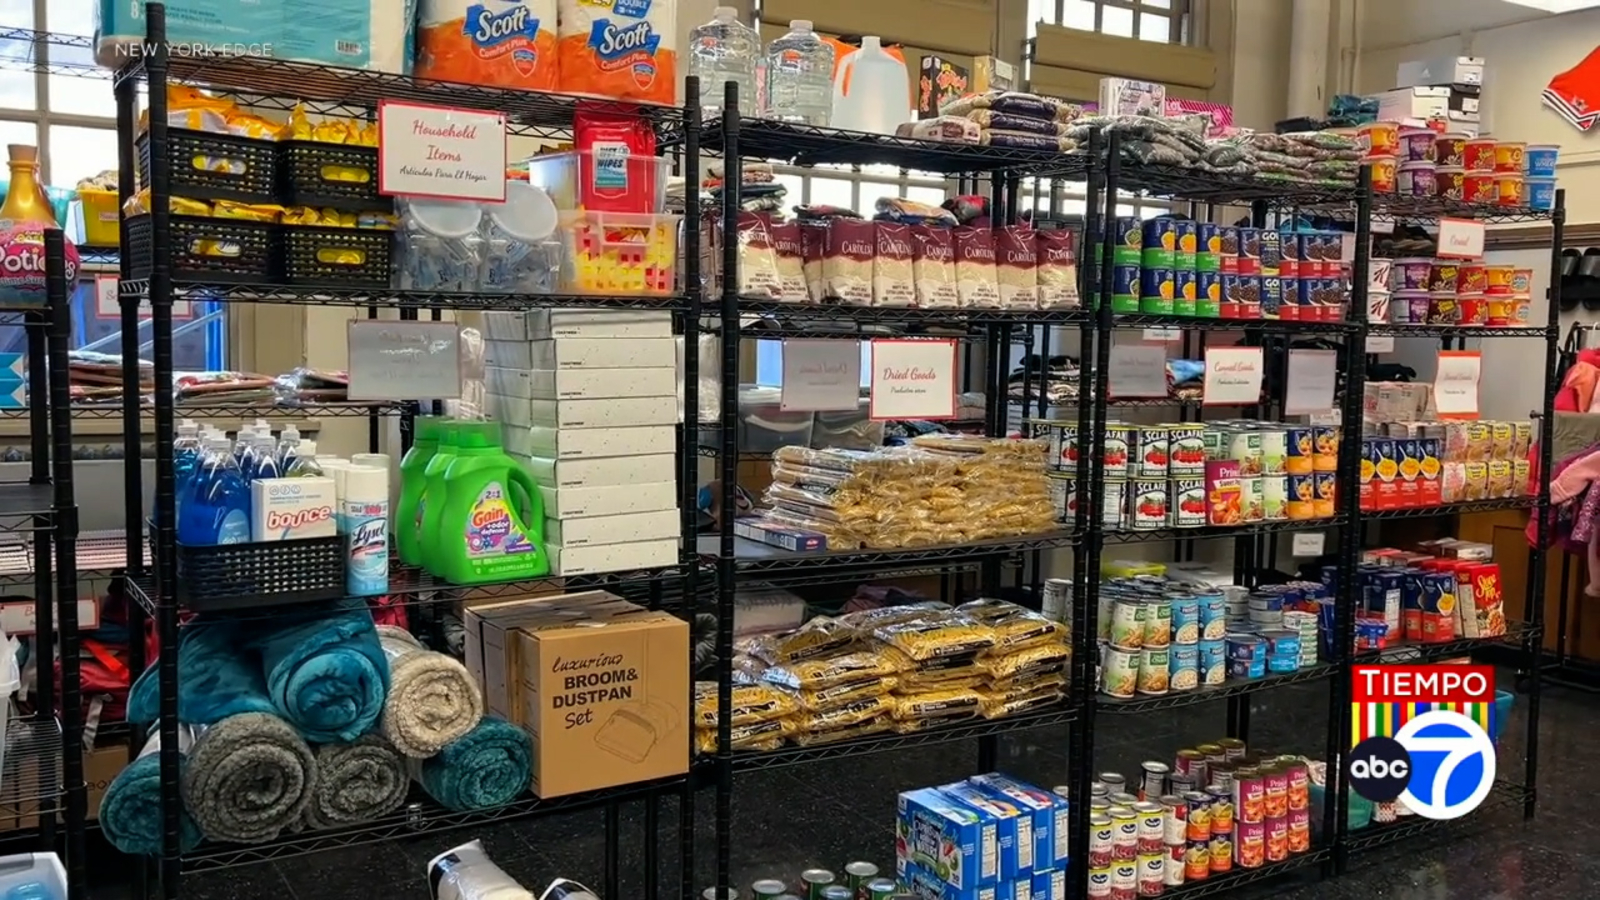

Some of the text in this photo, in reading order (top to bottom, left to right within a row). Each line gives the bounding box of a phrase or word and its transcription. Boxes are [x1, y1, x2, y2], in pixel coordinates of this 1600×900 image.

[475, 7, 527, 42] Scott
[479, 38, 528, 58] Comfort Plus
[599, 22, 649, 55] Scott
[601, 52, 648, 69] Comfort Plus
[412, 119, 478, 140] Household
[426, 144, 462, 162] Items
[597, 159, 624, 168] WIPES
[434, 168, 453, 178] Para
[465, 170, 487, 183] Hogar
[883, 366, 936, 381] Dried Goods
[268, 506, 331, 529] bounce
[472, 508, 504, 528] Gain
[352, 521, 386, 546] Lysol
[552, 653, 623, 673] luxurious
[564, 668, 638, 690] BROOM&
[552, 685, 632, 709] DUSTPAN
[565, 708, 593, 730] Set
